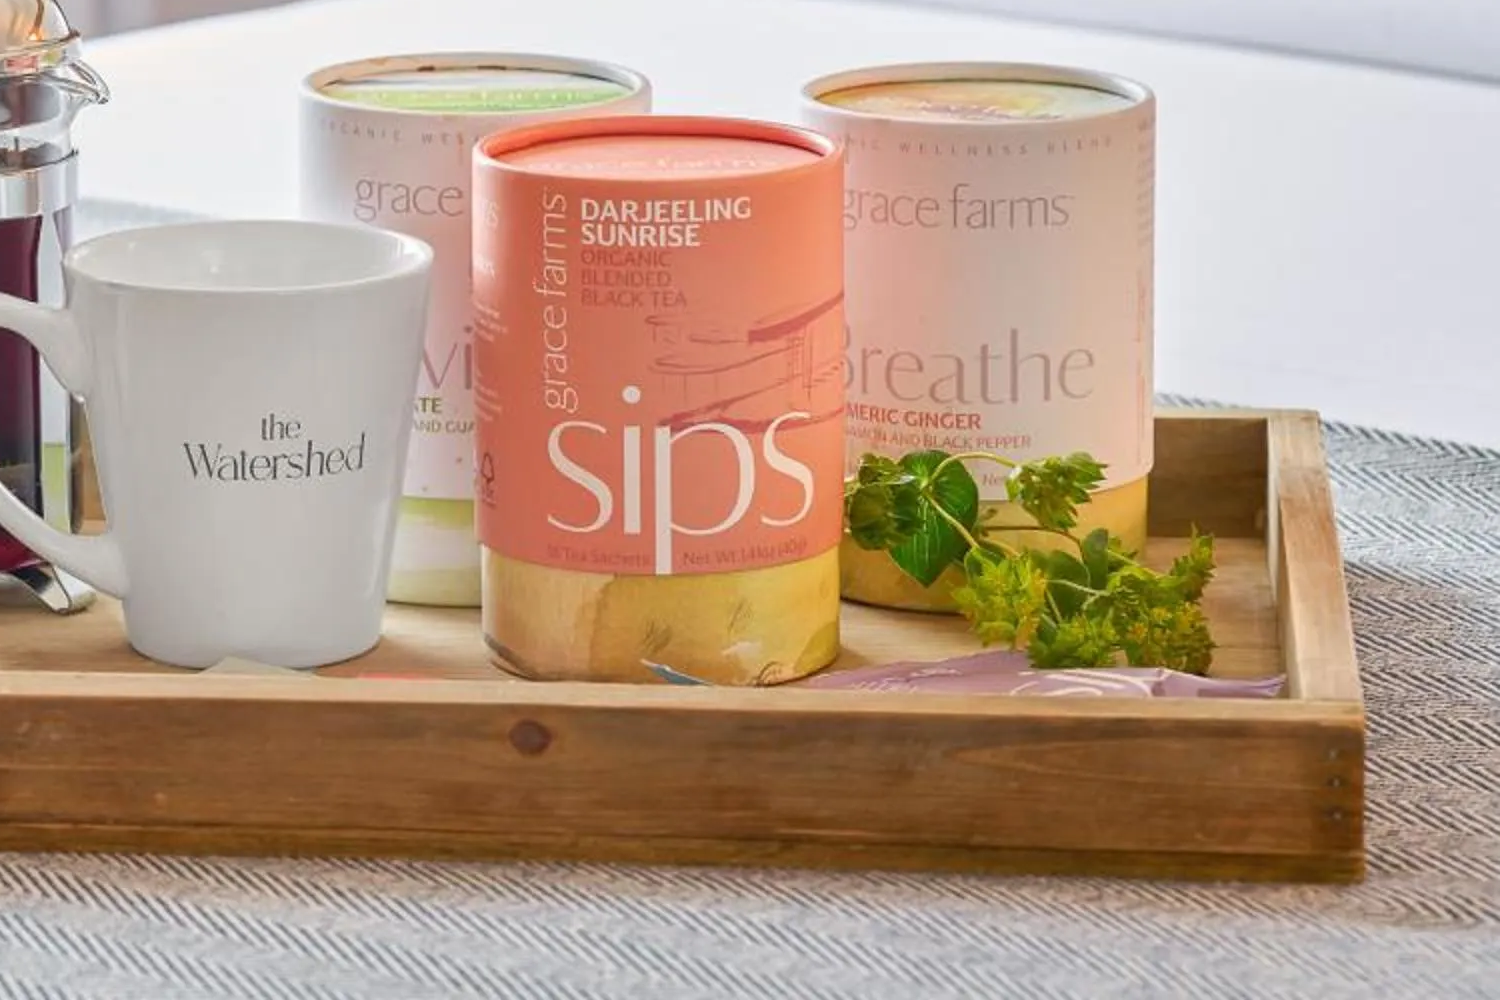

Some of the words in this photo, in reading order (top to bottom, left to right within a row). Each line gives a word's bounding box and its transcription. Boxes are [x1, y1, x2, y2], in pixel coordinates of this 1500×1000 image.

[354, 178, 464, 222] grace
[580, 196, 752, 223] DARJEELING
[843, 189, 941, 231] grace
[948, 183, 1075, 230] farms
[532, 186, 567, 297] farms
[580, 223, 701, 247] SUNRISE
[581, 250, 671, 268] ORGANIC
[581, 269, 672, 287] BLENDED
[581, 288, 643, 306] BLACK
[651, 290, 687, 307] TEA
[543, 304, 579, 413] grace
[260, 413, 302, 440] the
[846, 404, 900, 425] MERIC
[903, 410, 982, 430] GINGER
[923, 433, 973, 450] BLACK
[976, 434, 1032, 449] PEPPER
[182, 431, 366, 481] Watershed
[547, 385, 815, 576] sips
